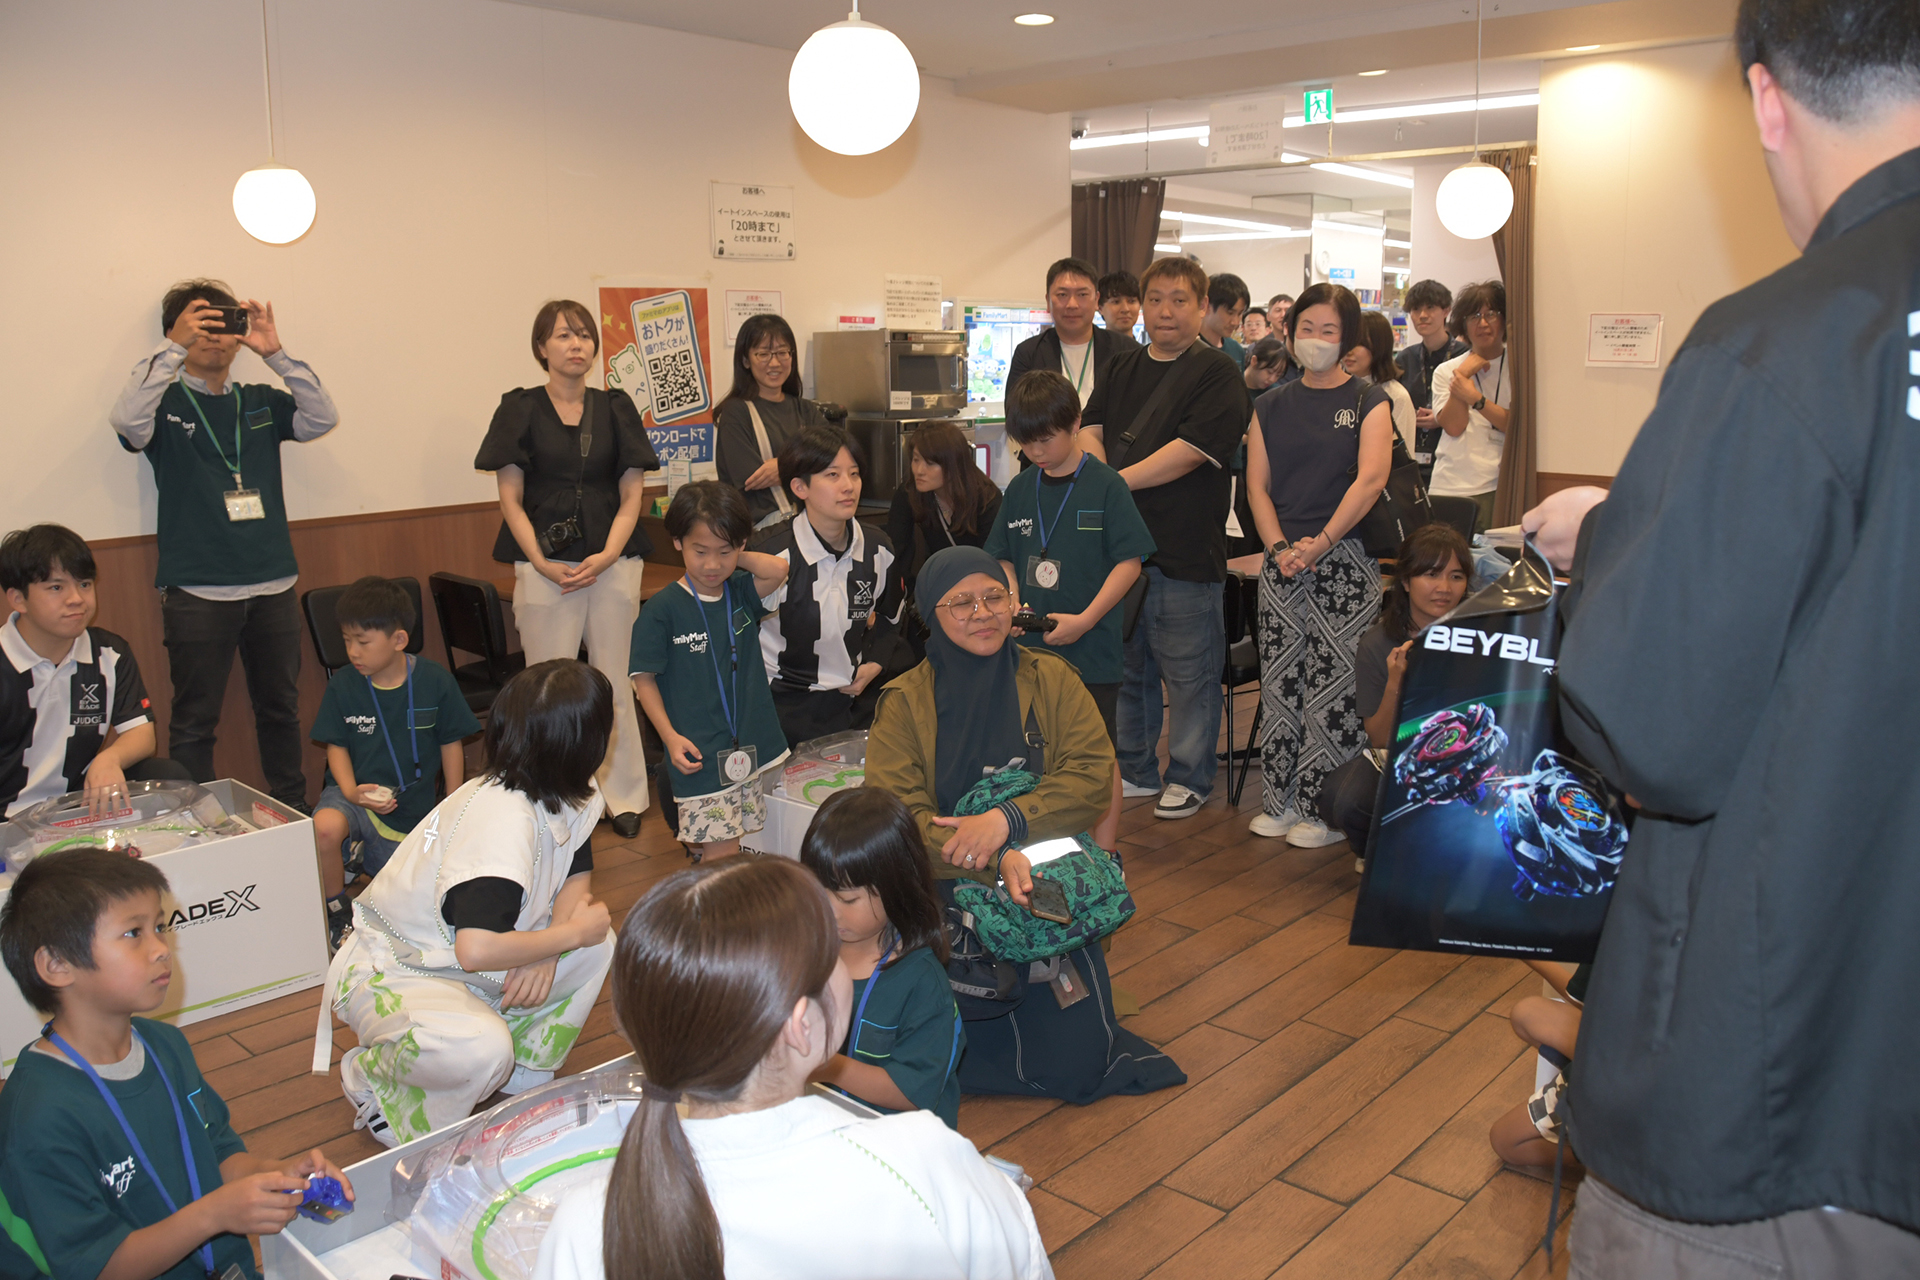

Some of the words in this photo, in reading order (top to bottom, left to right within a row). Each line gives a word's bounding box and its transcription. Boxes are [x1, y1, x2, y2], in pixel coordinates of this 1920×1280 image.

[742, 187, 766, 195] お客様へ
[718, 208, 791, 219] イートインスペースの使用は
[730, 219, 780, 233] 「20時まで」
[641, 304, 680, 319] ファミマのアプリは
[641, 315, 685, 340] おトクが
[656, 444, 707, 461] ポン配信!
[72, 714, 103, 725] JUDGE
